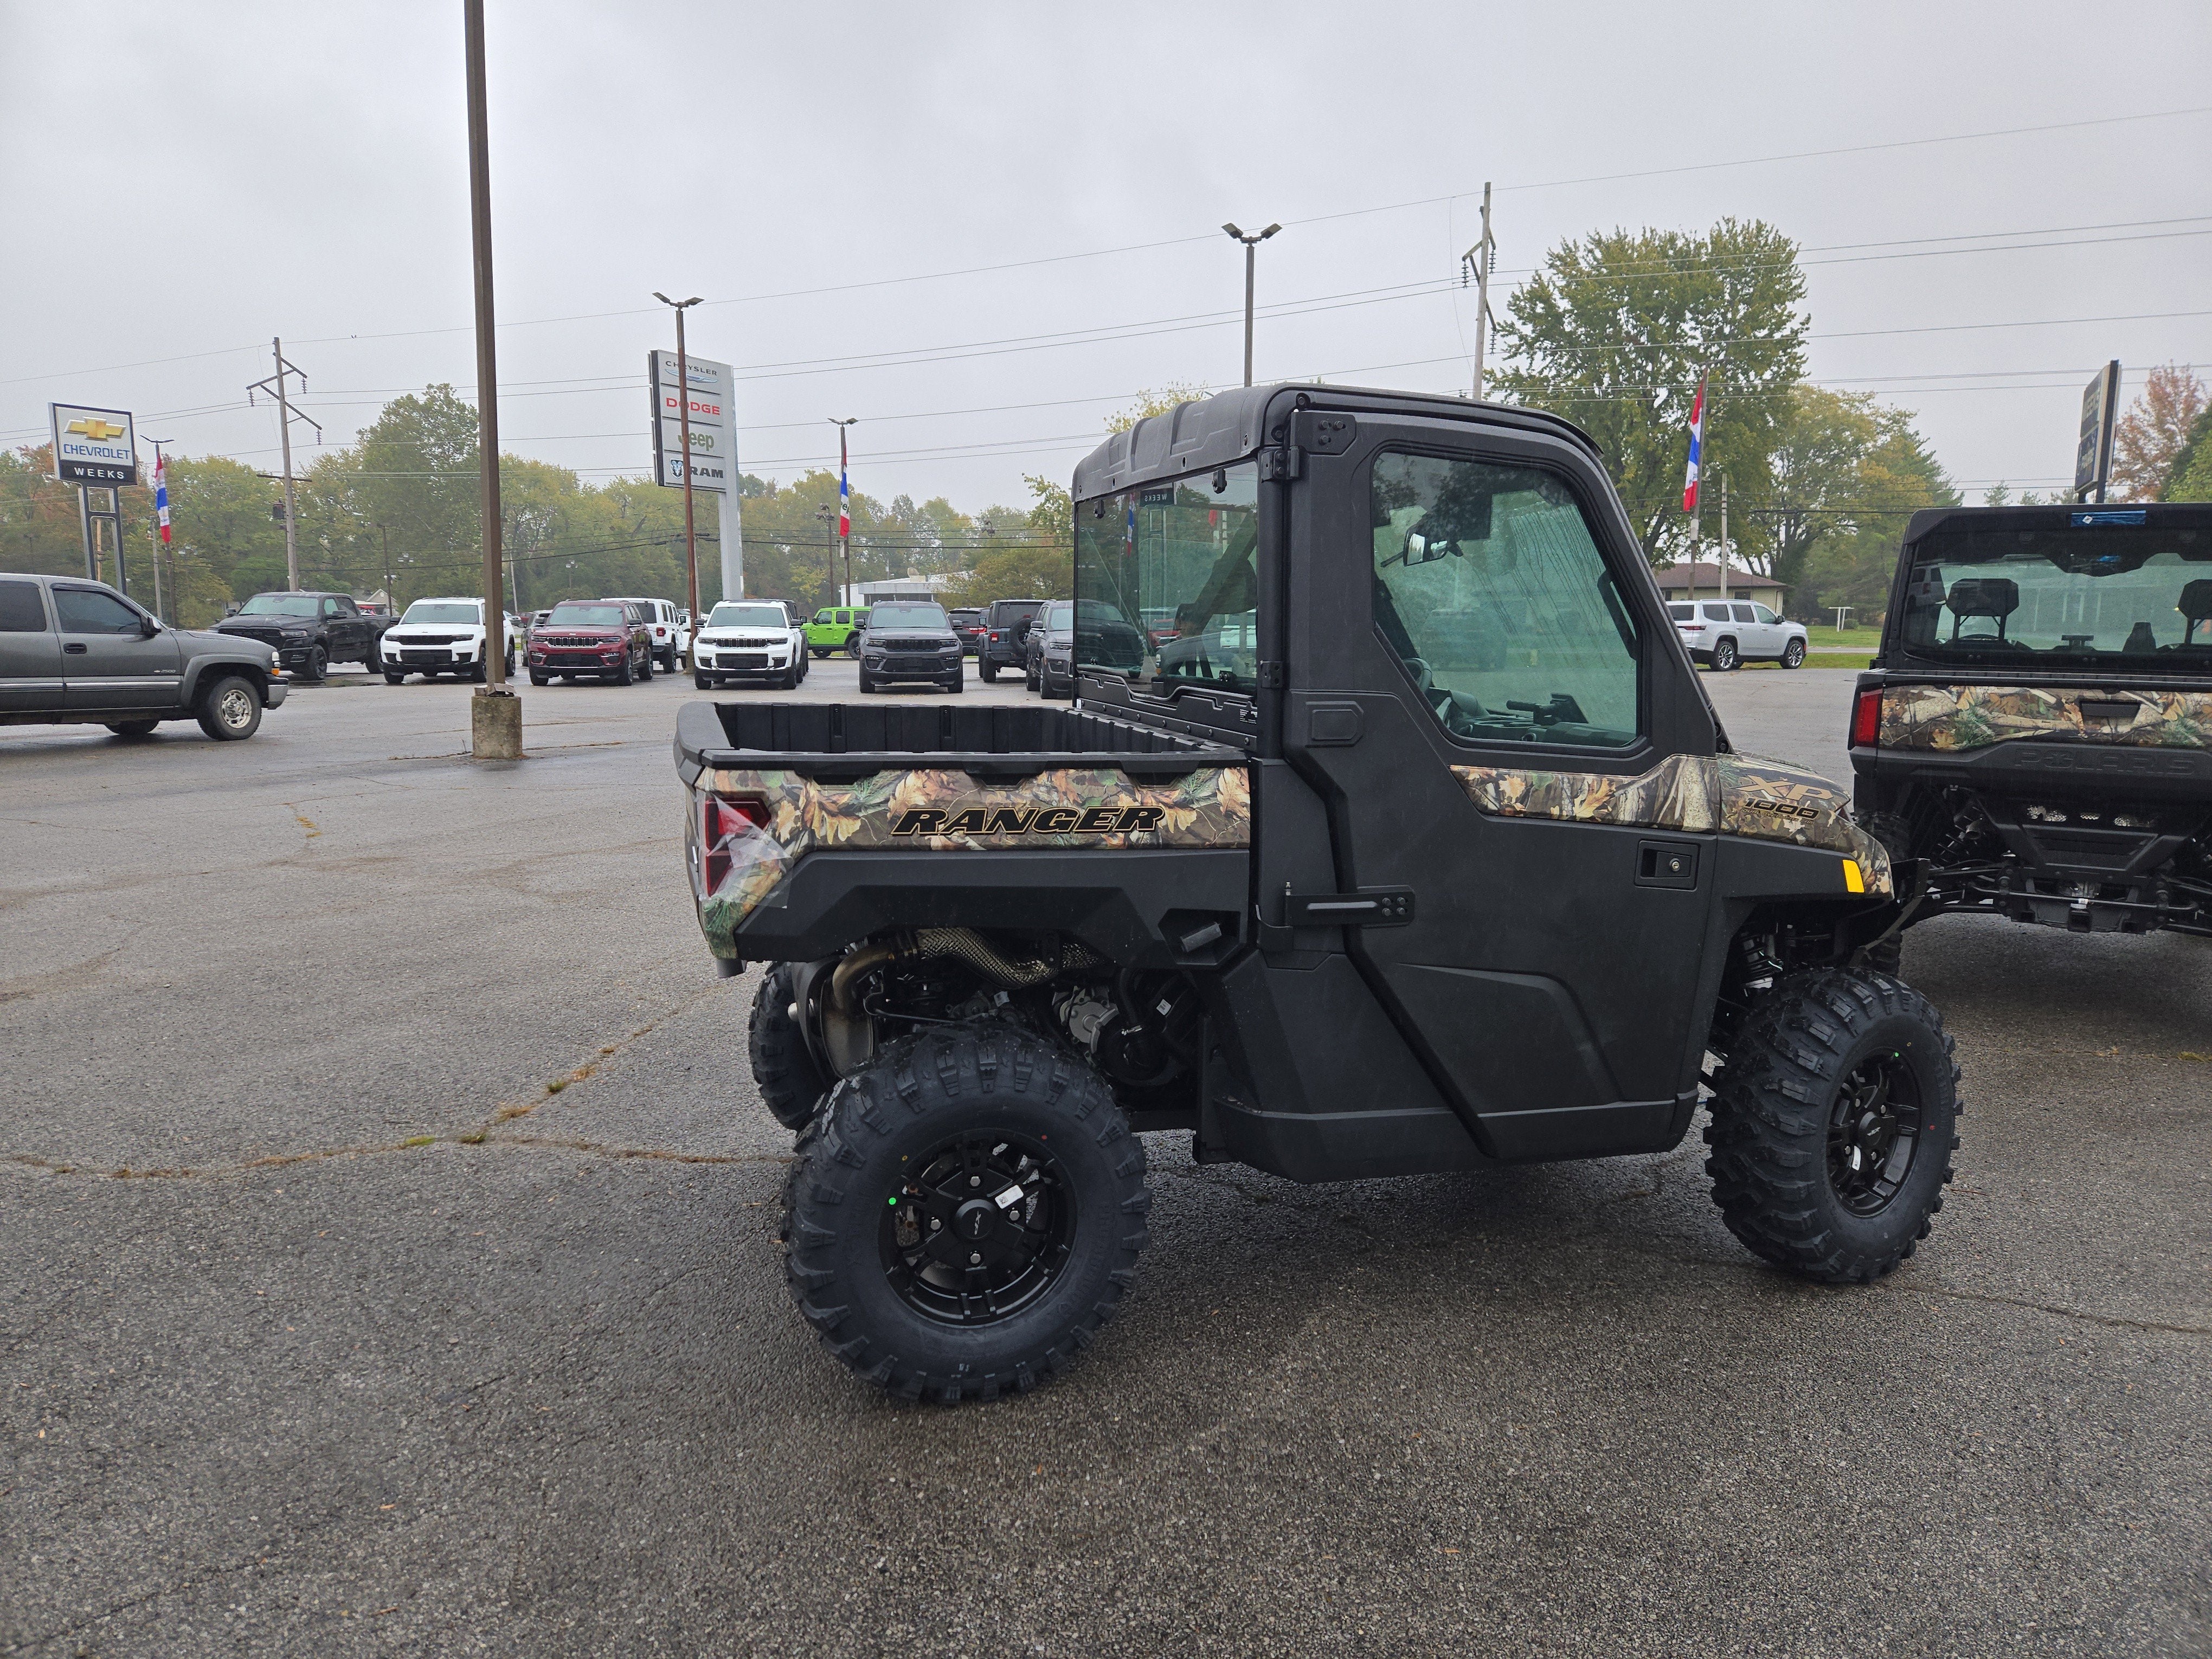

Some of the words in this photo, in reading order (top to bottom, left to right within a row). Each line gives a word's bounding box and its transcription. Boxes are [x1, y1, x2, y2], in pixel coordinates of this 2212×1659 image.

[665, 361, 717, 375] CHYSLER
[63, 443, 130, 459] CHEVROLET
[74, 467, 124, 479] WEEKS
[2015, 748, 2197, 775] POLARIS
[1735, 774, 1834, 801] XP
[1744, 798, 1819, 819] 1000
[890, 806, 1165, 834] RANGER
